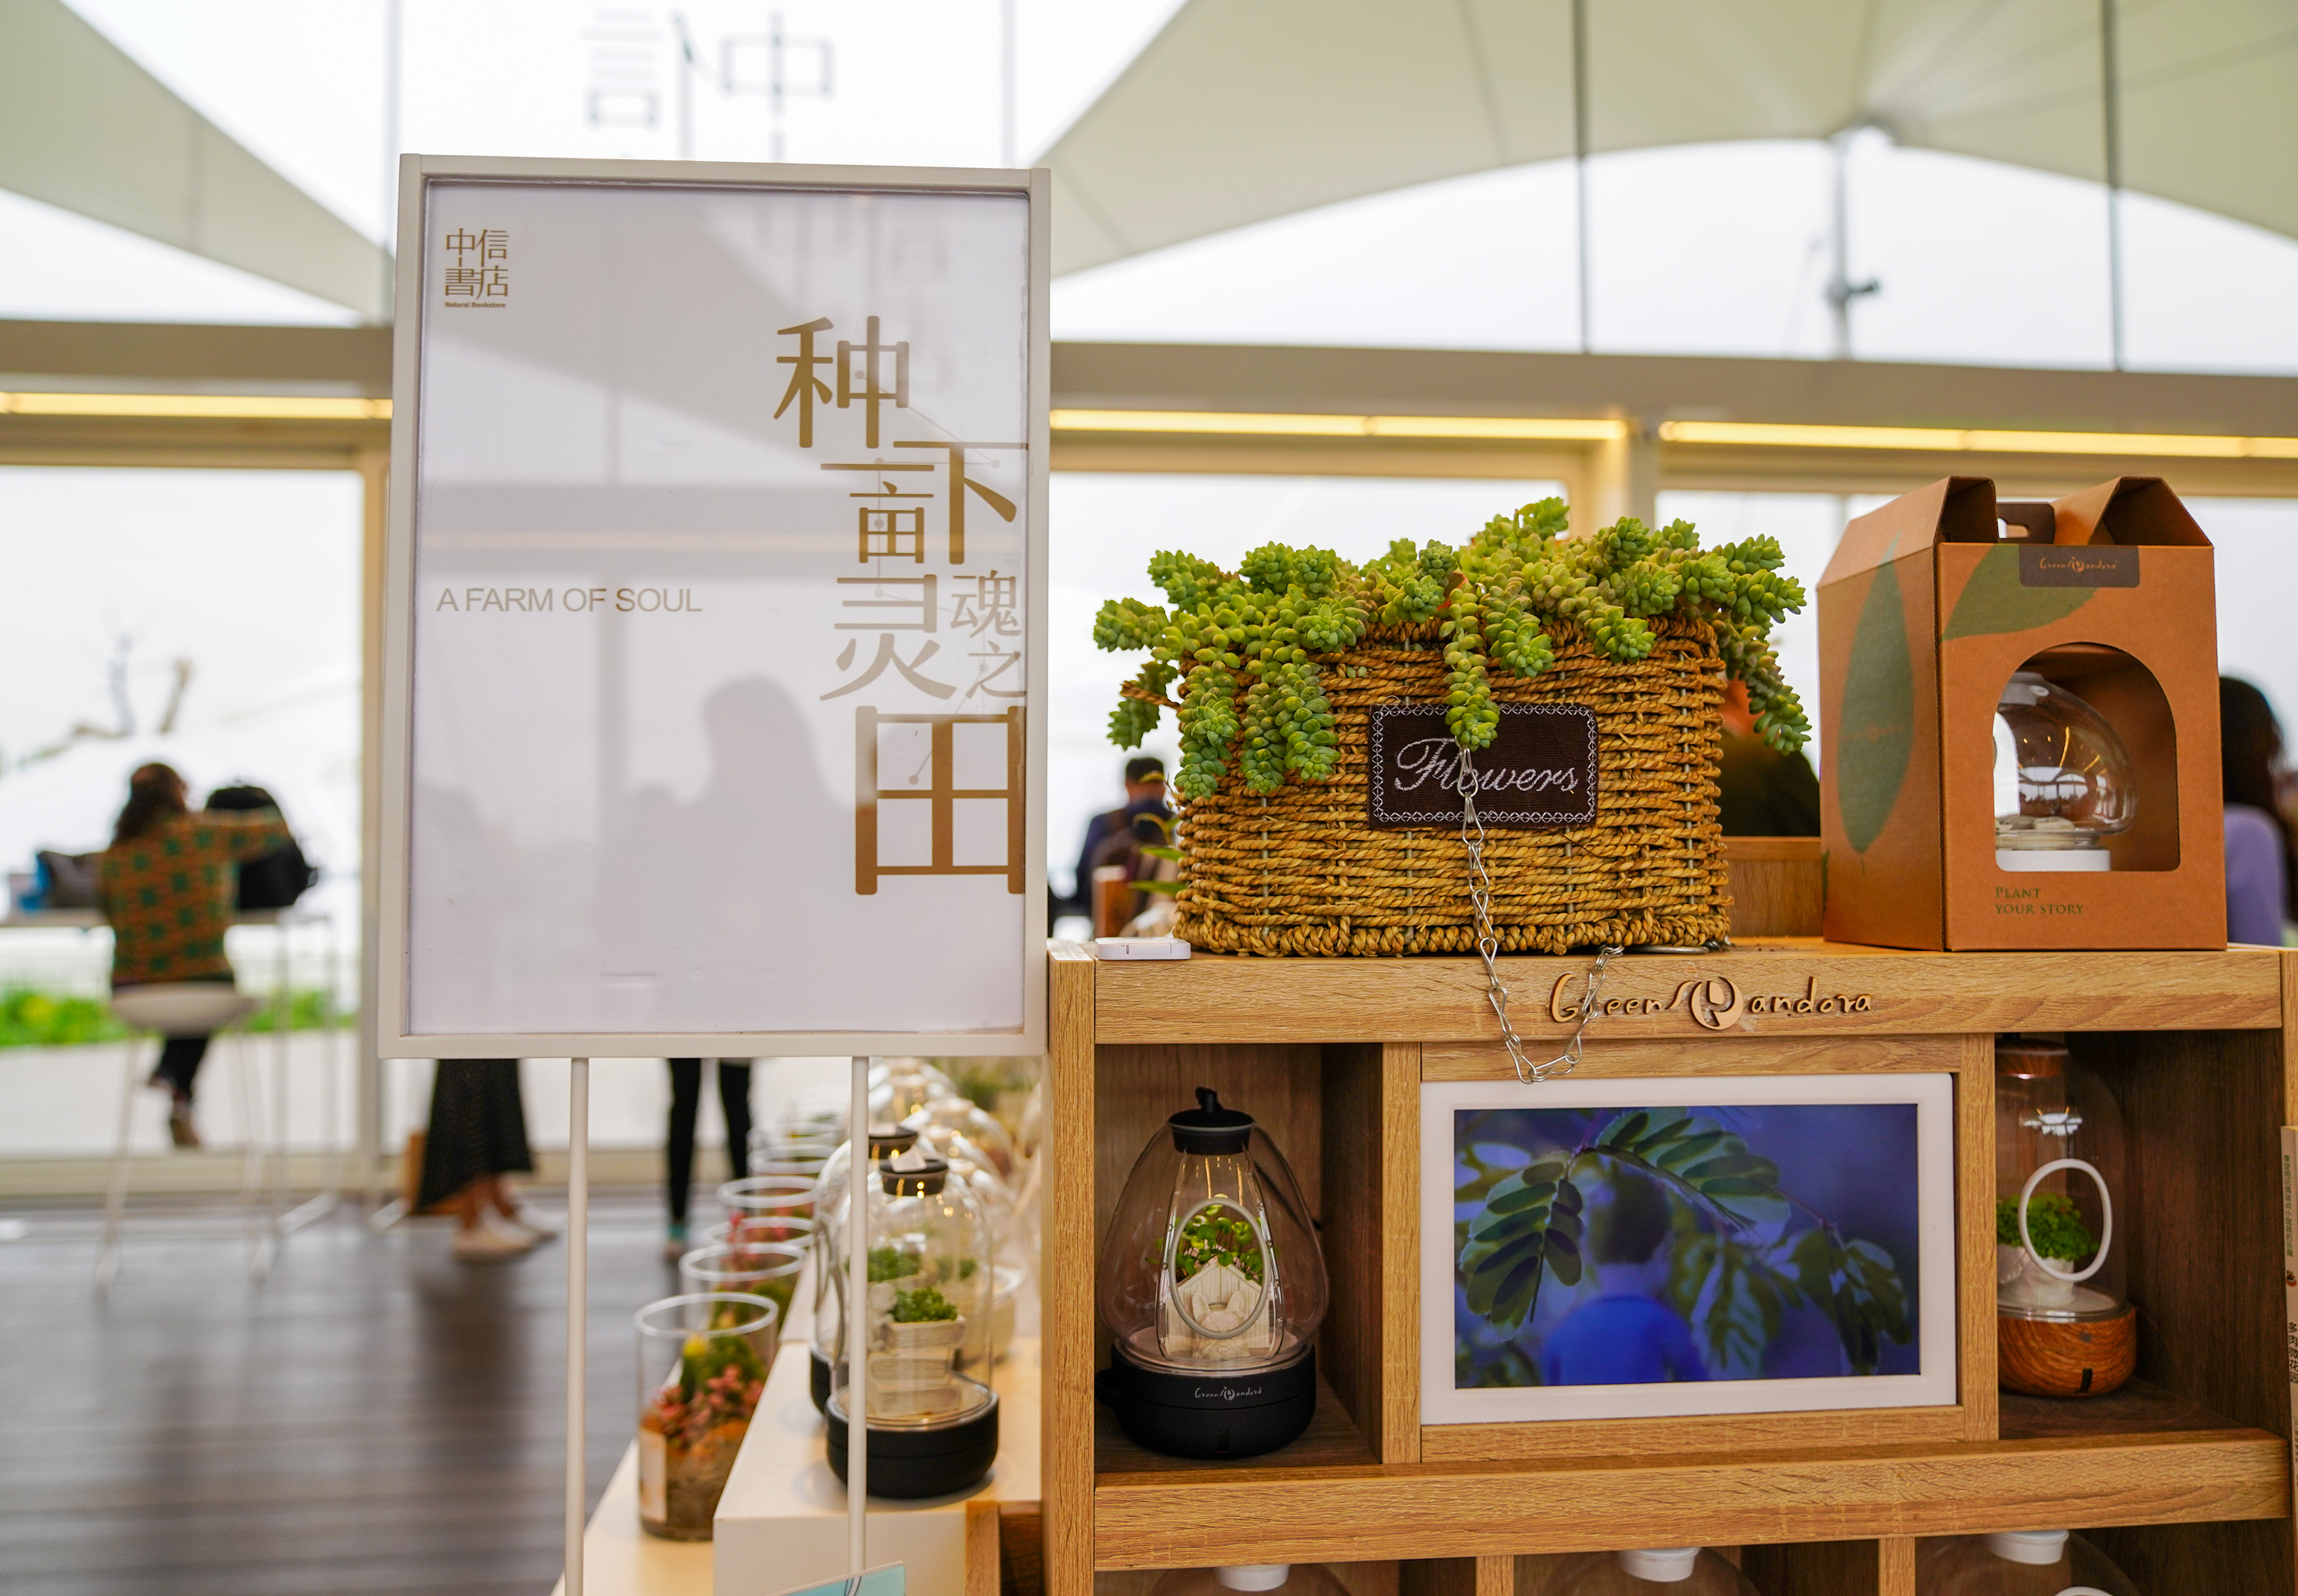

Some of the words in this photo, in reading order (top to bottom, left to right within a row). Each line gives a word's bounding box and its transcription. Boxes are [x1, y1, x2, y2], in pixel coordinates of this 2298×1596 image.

[446, 227, 509, 267] 中信
[445, 265, 509, 299] 書店
[436, 589, 459, 612] A
[466, 588, 553, 612] FARM
[562, 588, 607, 612] OF
[615, 588, 702, 612] SOUL
[1394, 737, 1579, 792] Flowers
[1994, 904, 2034, 914] YOUR
[2039, 904, 2084, 914] STORY
[1194, 1387, 1219, 1398] Green
